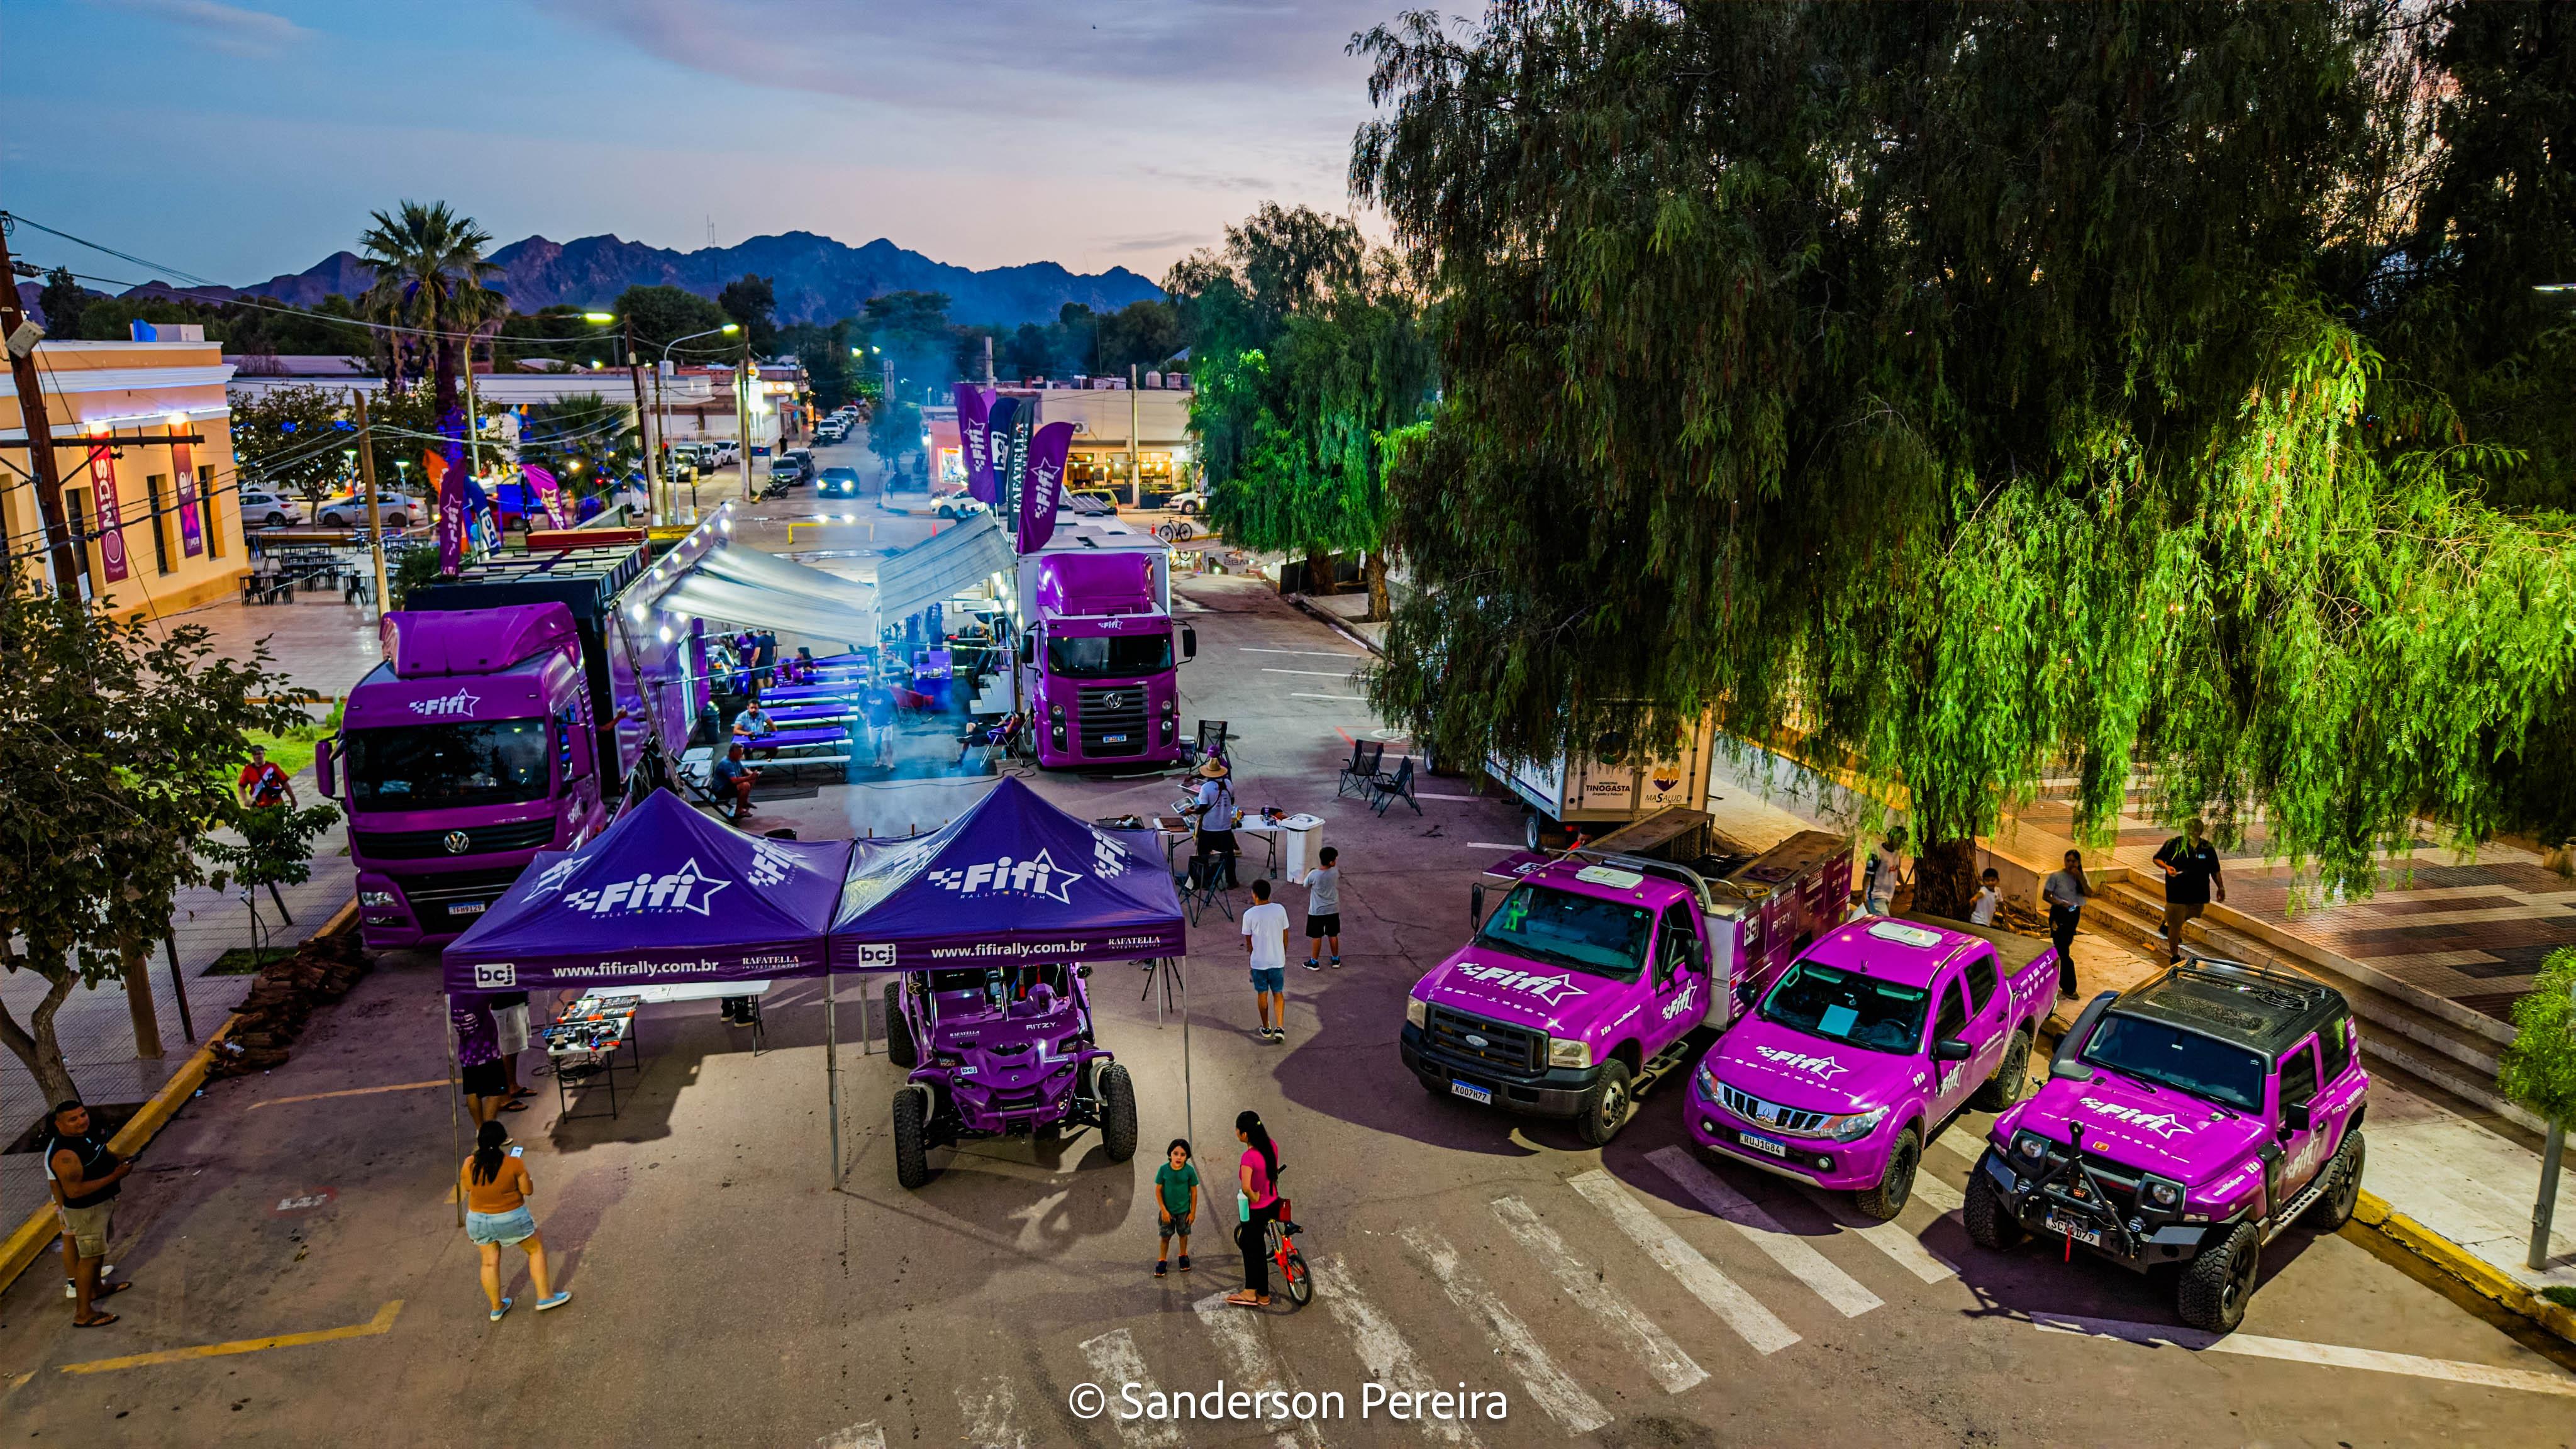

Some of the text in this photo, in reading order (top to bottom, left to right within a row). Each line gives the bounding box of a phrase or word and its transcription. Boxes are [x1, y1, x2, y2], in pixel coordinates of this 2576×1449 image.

[969, 428, 986, 465] Fifi
[1013, 423, 1025, 513] RAFATELLA
[1035, 470, 1056, 514] Fifi
[425, 696, 465, 715] Fifi
[962, 856, 1050, 894] Fifi
[595, 873, 696, 913] Fifi
[960, 891, 1045, 899] RALLY TEAM
[591, 911, 630, 919] RALLY
[1745, 917, 1758, 938] bcj
[1772, 911, 1791, 931] RITZY
[861, 936, 1160, 965] bcj www.fifirally.com.br RAFATELLA
[477, 955, 799, 985] bcj www.fifirally.com.br RAFATELLA
[1473, 967, 1563, 996] Fifi
[1668, 987, 1692, 1019] Fifi
[1026, 1021, 1057, 1031] RITZY
[1770, 1050, 1831, 1073] Fifi
[2096, 1103, 2170, 1130] Fifi
[1744, 1135, 1780, 1154] RUJ1G84
[2052, 1221, 2094, 1242] SCXD79
